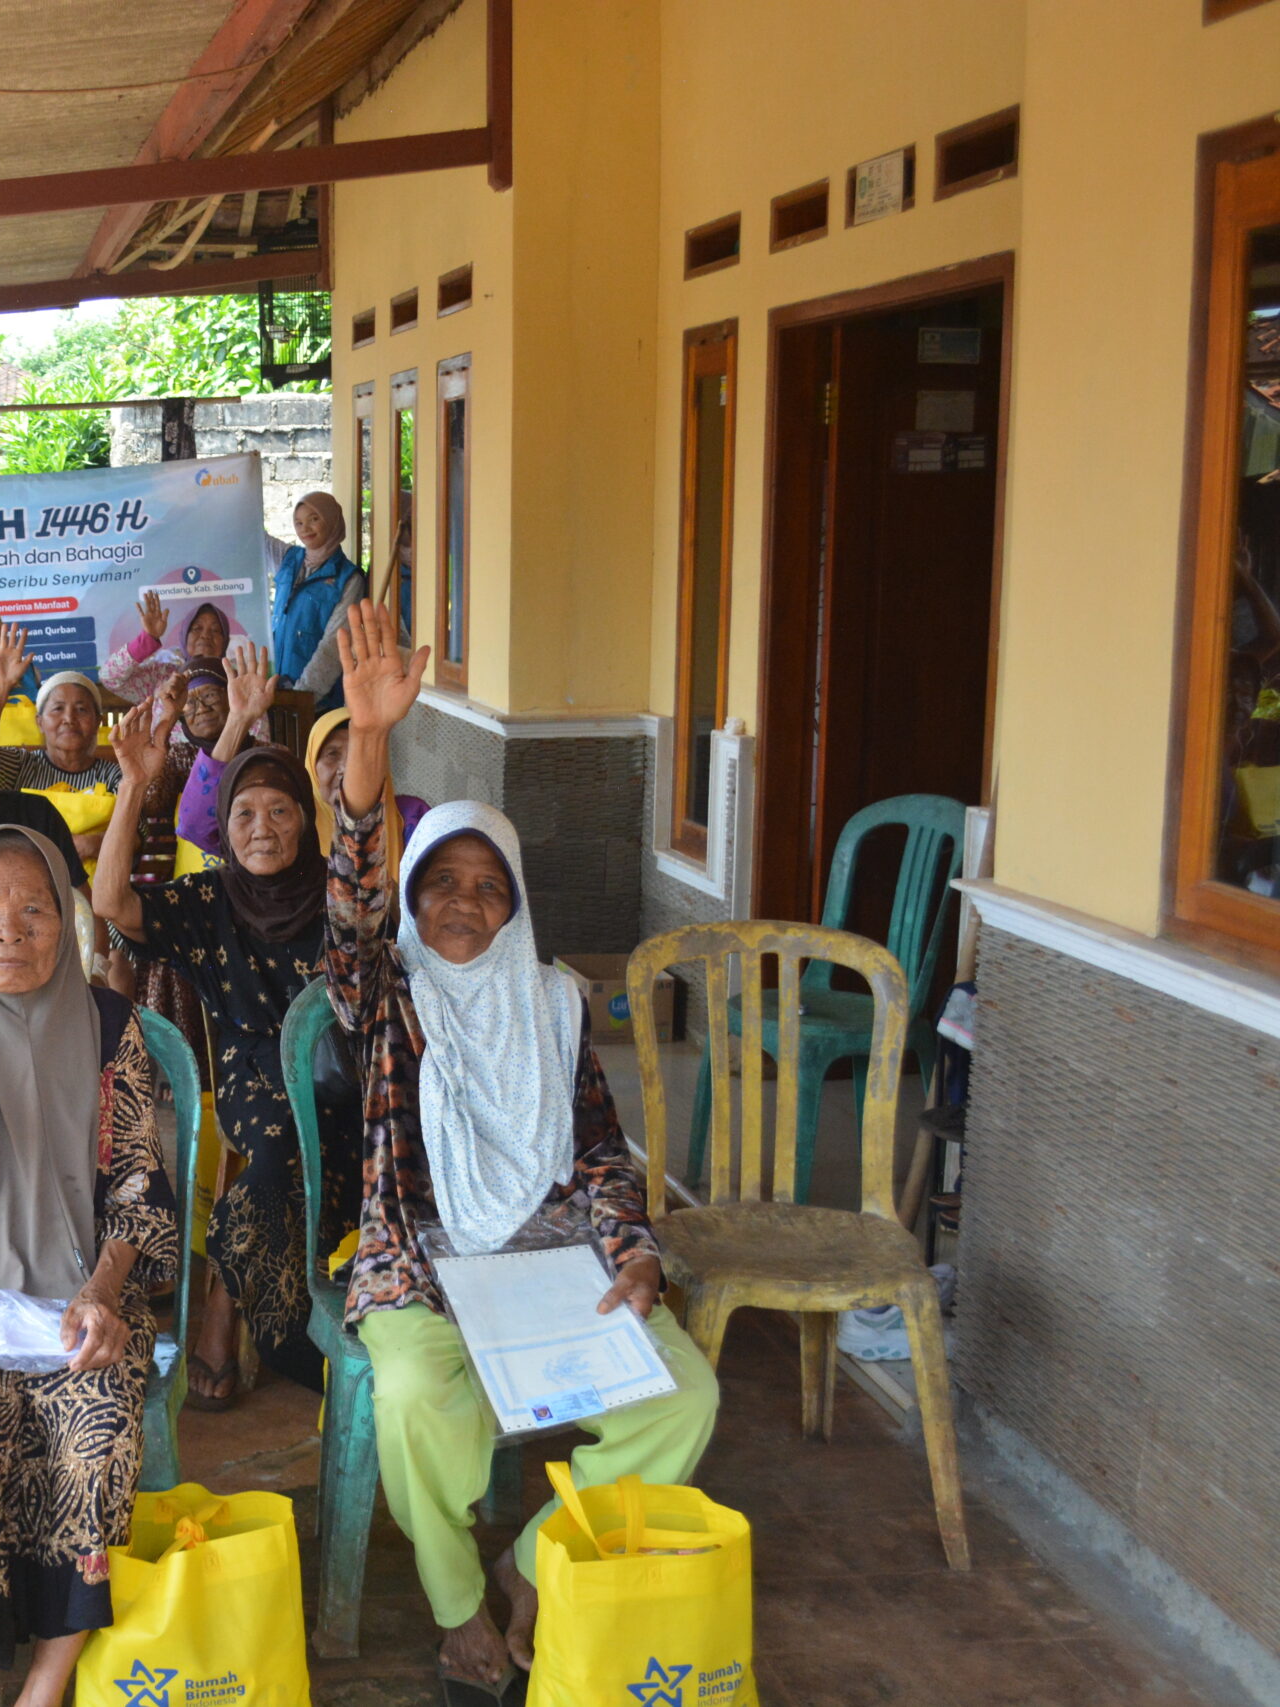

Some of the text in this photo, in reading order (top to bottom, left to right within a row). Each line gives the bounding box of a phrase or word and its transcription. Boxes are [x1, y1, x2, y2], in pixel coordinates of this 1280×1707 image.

[35, 502, 110, 537] 1446
[116, 499, 148, 532] H
[24, 548, 61, 564] dan
[66, 541, 143, 563] Bahagia
[213, 583, 245, 592] Subang
[33, 600, 70, 611] Manfaat
[45, 626, 77, 637] Qurban
[45, 651, 77, 663] Qurban
[185, 1669, 238, 1690] Rumah
[697, 1659, 742, 1684] Rumah
[185, 1684, 246, 1701] Bintang
[697, 1675, 744, 1698] Bintan
